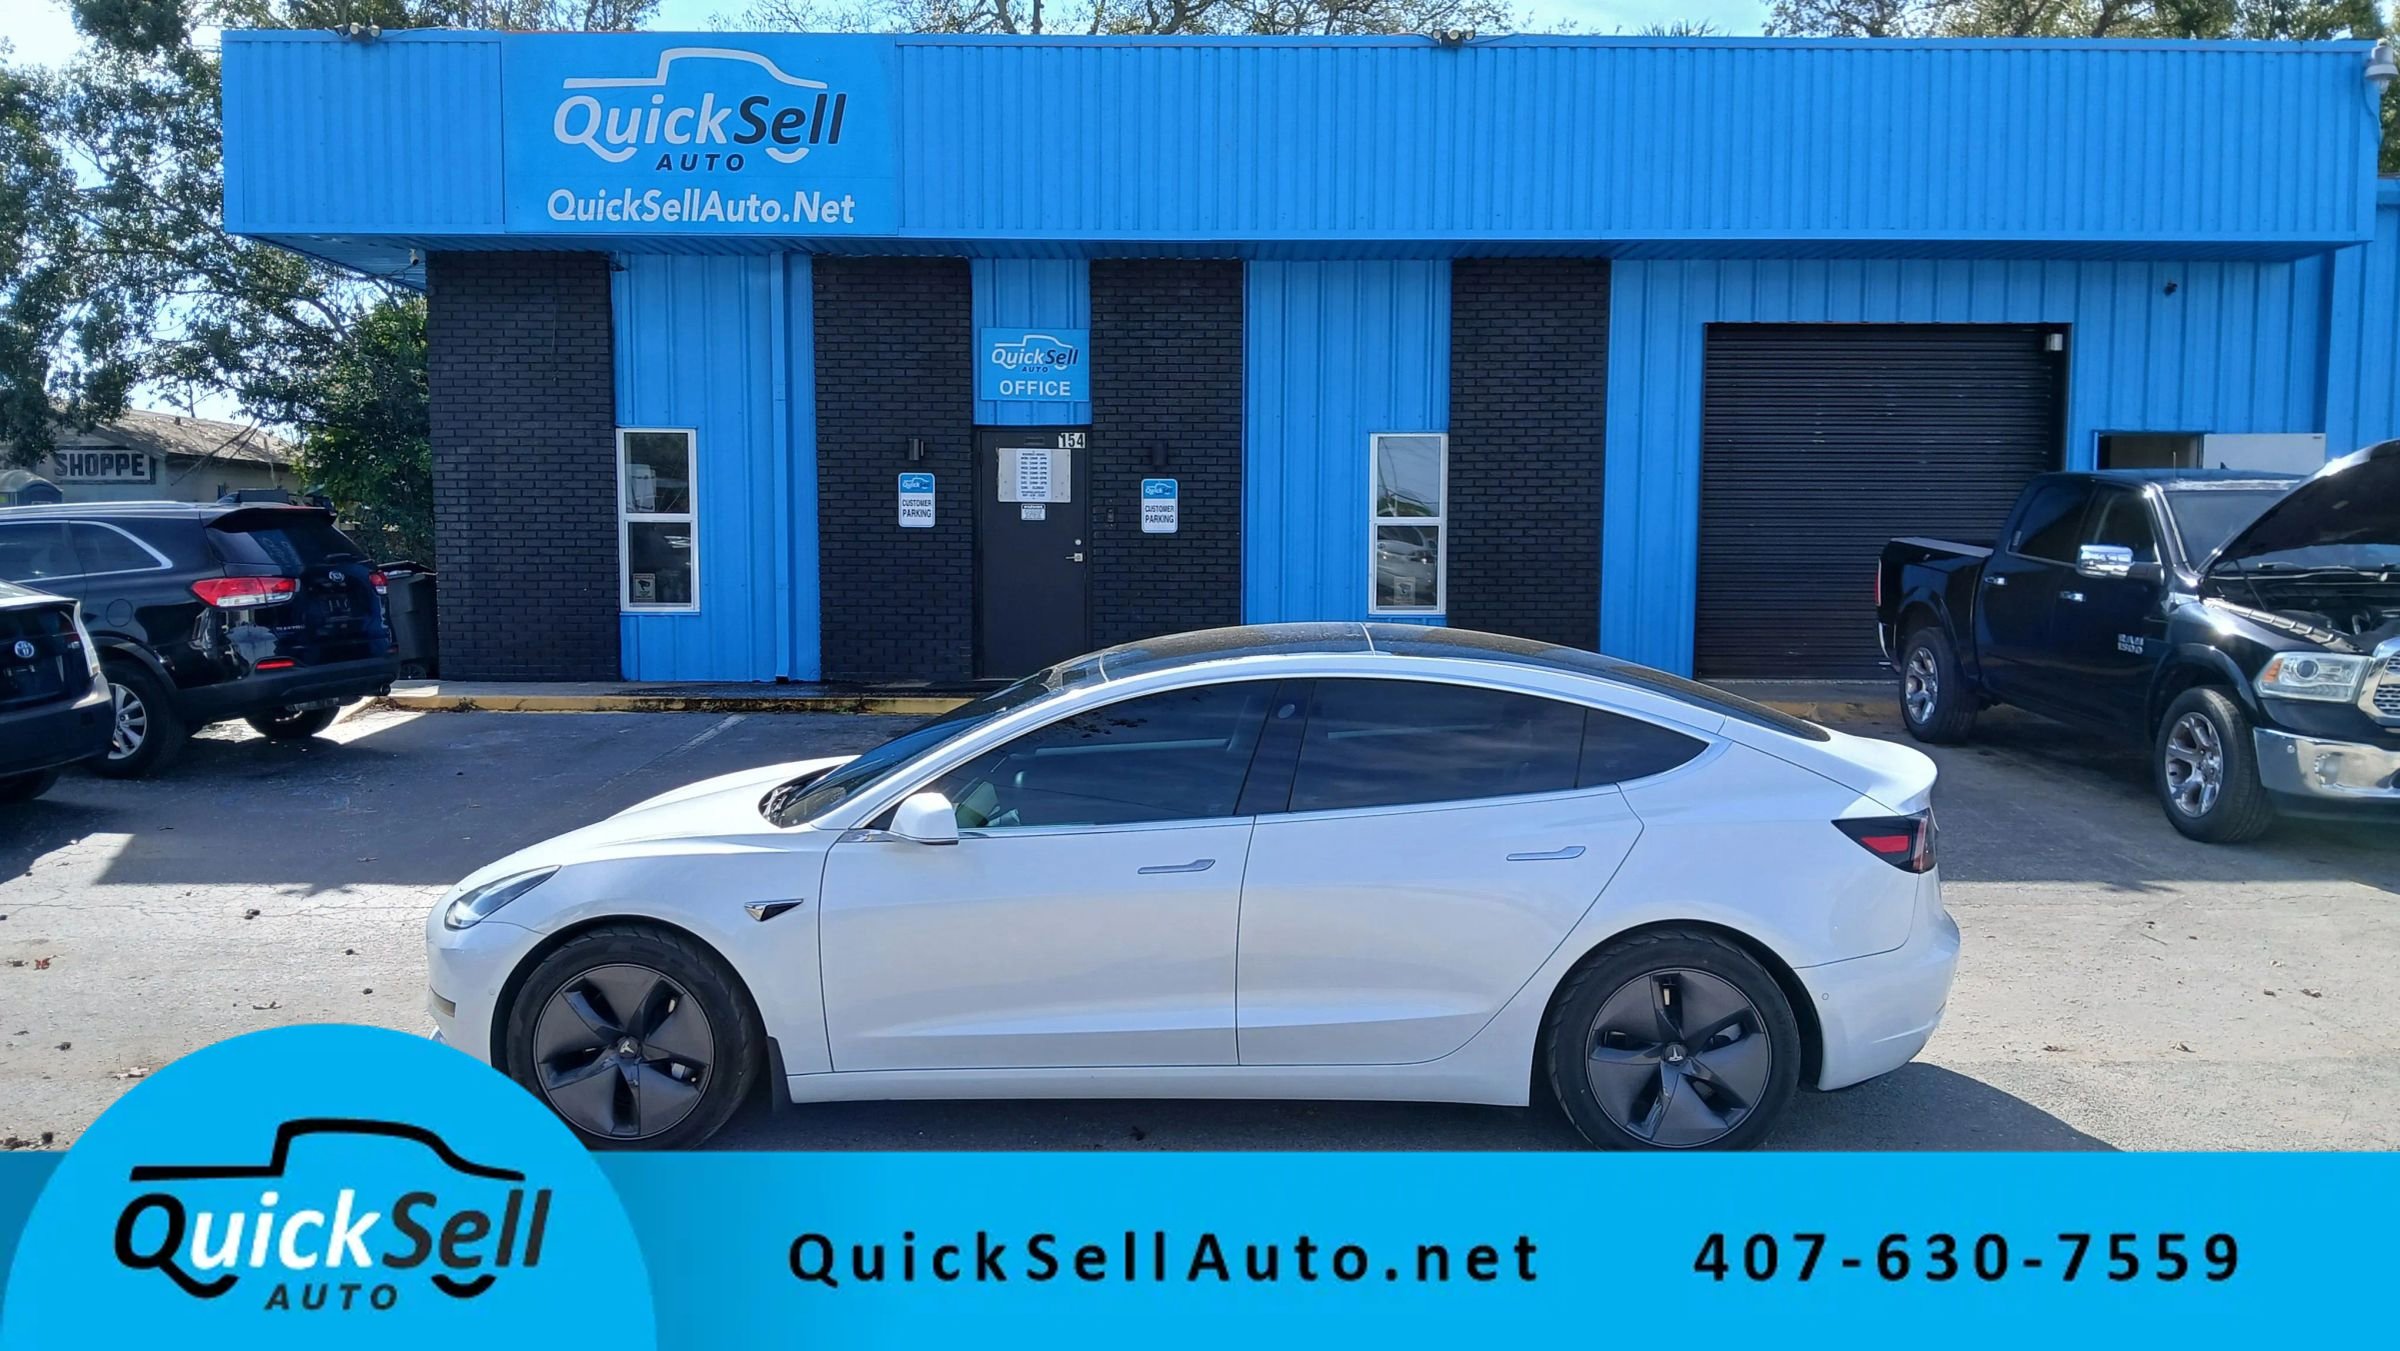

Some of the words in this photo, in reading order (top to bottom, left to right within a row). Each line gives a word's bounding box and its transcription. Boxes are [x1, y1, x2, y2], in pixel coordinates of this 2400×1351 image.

[553, 92, 847, 162] QuickSell
[655, 153, 745, 172] AUTO
[547, 188, 856, 224] QuickSellAuto.Net
[991, 348, 1079, 369] QuickSell
[1000, 380, 1071, 396] OFFICE
[1059, 432, 1085, 448] 154
[54, 453, 145, 477] SHOPPE
[902, 499, 931, 507] CUSTOMER
[1145, 505, 1174, 513] CUSTOMER
[902, 508, 932, 518] PARKING
[1144, 514, 1174, 524] PARKING
